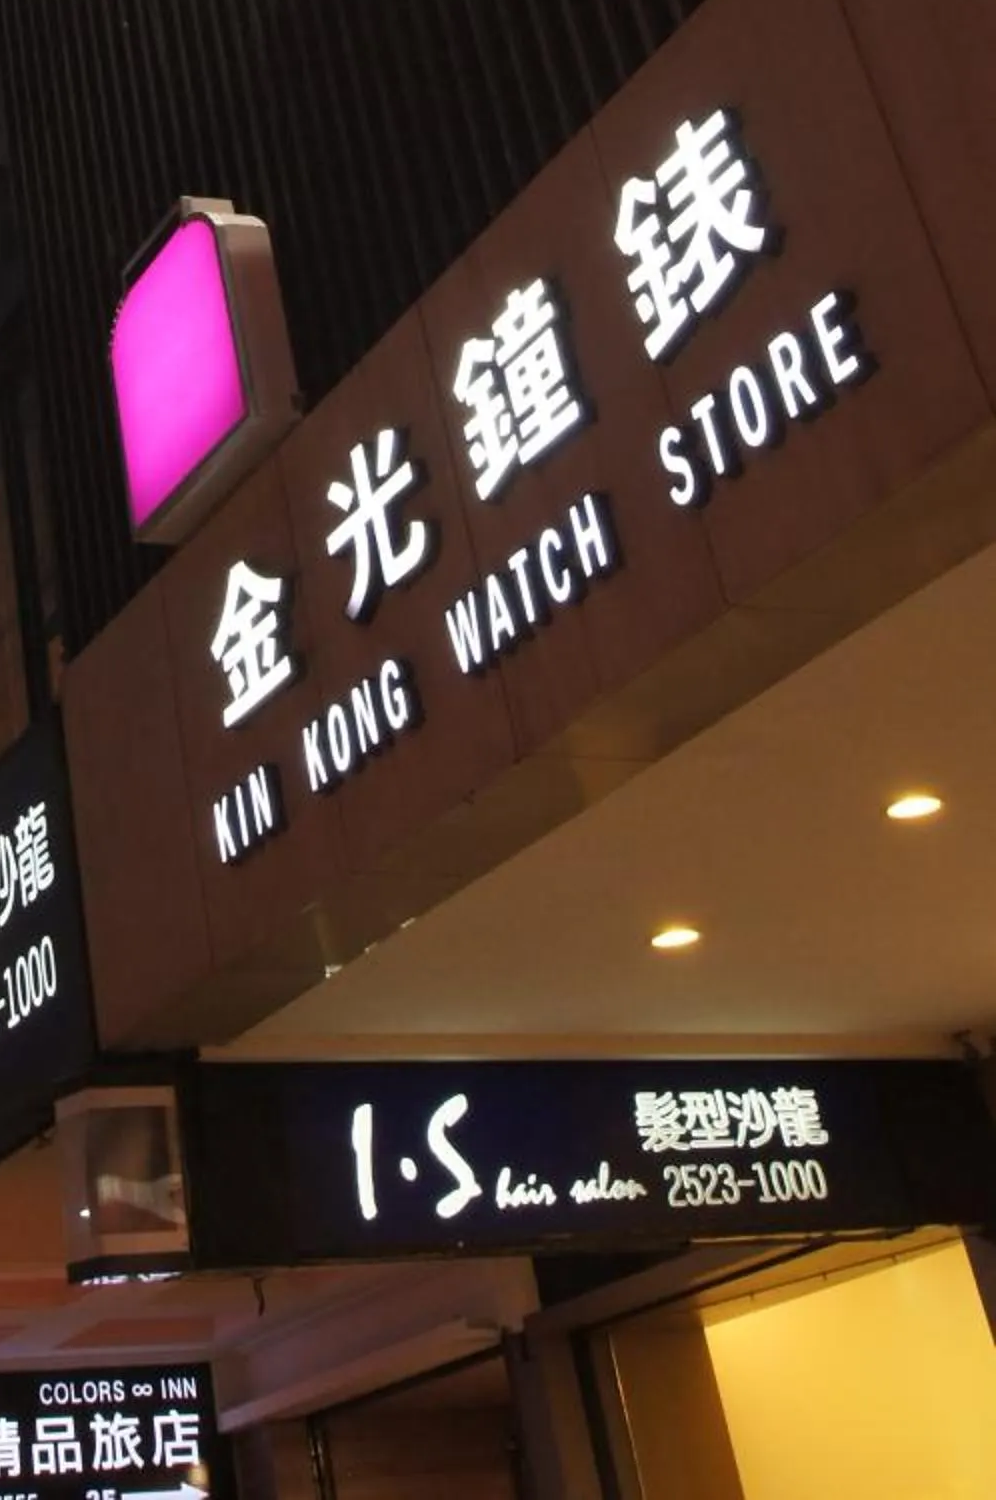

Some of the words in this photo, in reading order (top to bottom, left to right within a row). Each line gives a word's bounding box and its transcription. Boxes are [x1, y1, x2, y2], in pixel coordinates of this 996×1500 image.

[210, 109, 765, 729] 金光鐘錶
[213, 765, 273, 863] KIN
[302, 658, 409, 792] KONG
[445, 495, 613, 675] WATCH
[659, 292, 860, 506] STORE
[634, 1086, 829, 1153] 髮型沙龍
[663, 1159, 828, 1208] 2523-1000
[39, 1379, 126, 1405] COLORS
[160, 1377, 198, 1400] INN
